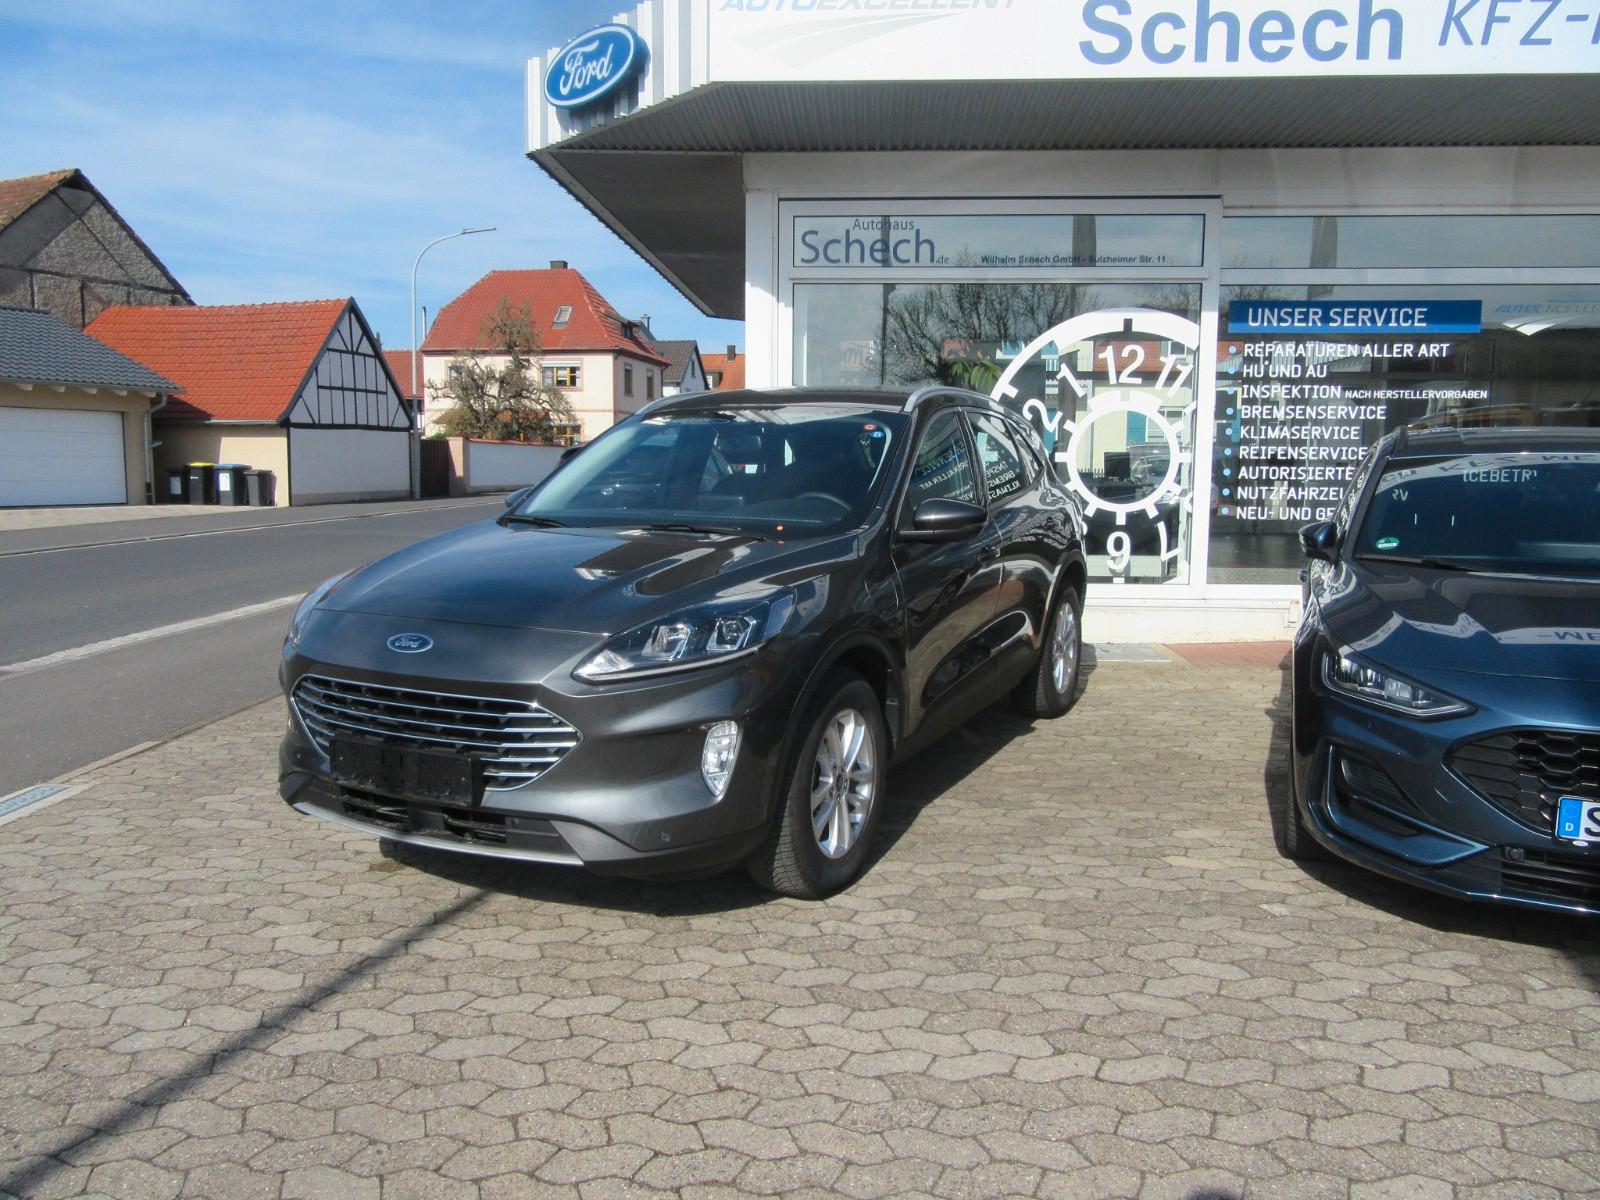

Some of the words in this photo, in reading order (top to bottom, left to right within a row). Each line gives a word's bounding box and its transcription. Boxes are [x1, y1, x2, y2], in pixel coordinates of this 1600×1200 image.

[1078, 0, 1403, 65] Schech
[1438, 0, 1600, 46] KFZ-
[559, 40, 614, 96] Ford
[852, 218, 915, 231] Autohaus
[981, 255, 1016, 264] Wilhelm
[1018, 255, 1050, 264] Schech
[1053, 255, 1081, 264] GmbH
[1139, 255, 1154, 263] Str.
[1157, 255, 1166, 263] 11
[1248, 308, 1322, 327] UNSER
[1328, 308, 1428, 327] SERVICE
[1243, 343, 1358, 358] REPARATUREN
[1361, 344, 1414, 358] ALLER
[1417, 344, 1450, 358] ART
[1098, 344, 1145, 385] 12
[1268, 364, 1301, 378] UND
[1305, 364, 1328, 378] AU
[1241, 384, 1342, 399] INSPEKTION
[1345, 390, 1372, 399] NACH
[1373, 390, 1488, 399] HERSTELLERVORGABEN
[1240, 405, 1387, 420] BREMSENSERVICE
[1239, 426, 1361, 440] KLIMASERVICE
[1239, 446, 1369, 460] REIFENSERVICE
[1238, 466, 1355, 480] AUTORISIERTE
[1463, 469, 1537, 483] ICEBETR
[1236, 506, 1275, 520] NEU-
[1279, 507, 1311, 520] UND
[1565, 822, 1574, 832] D
